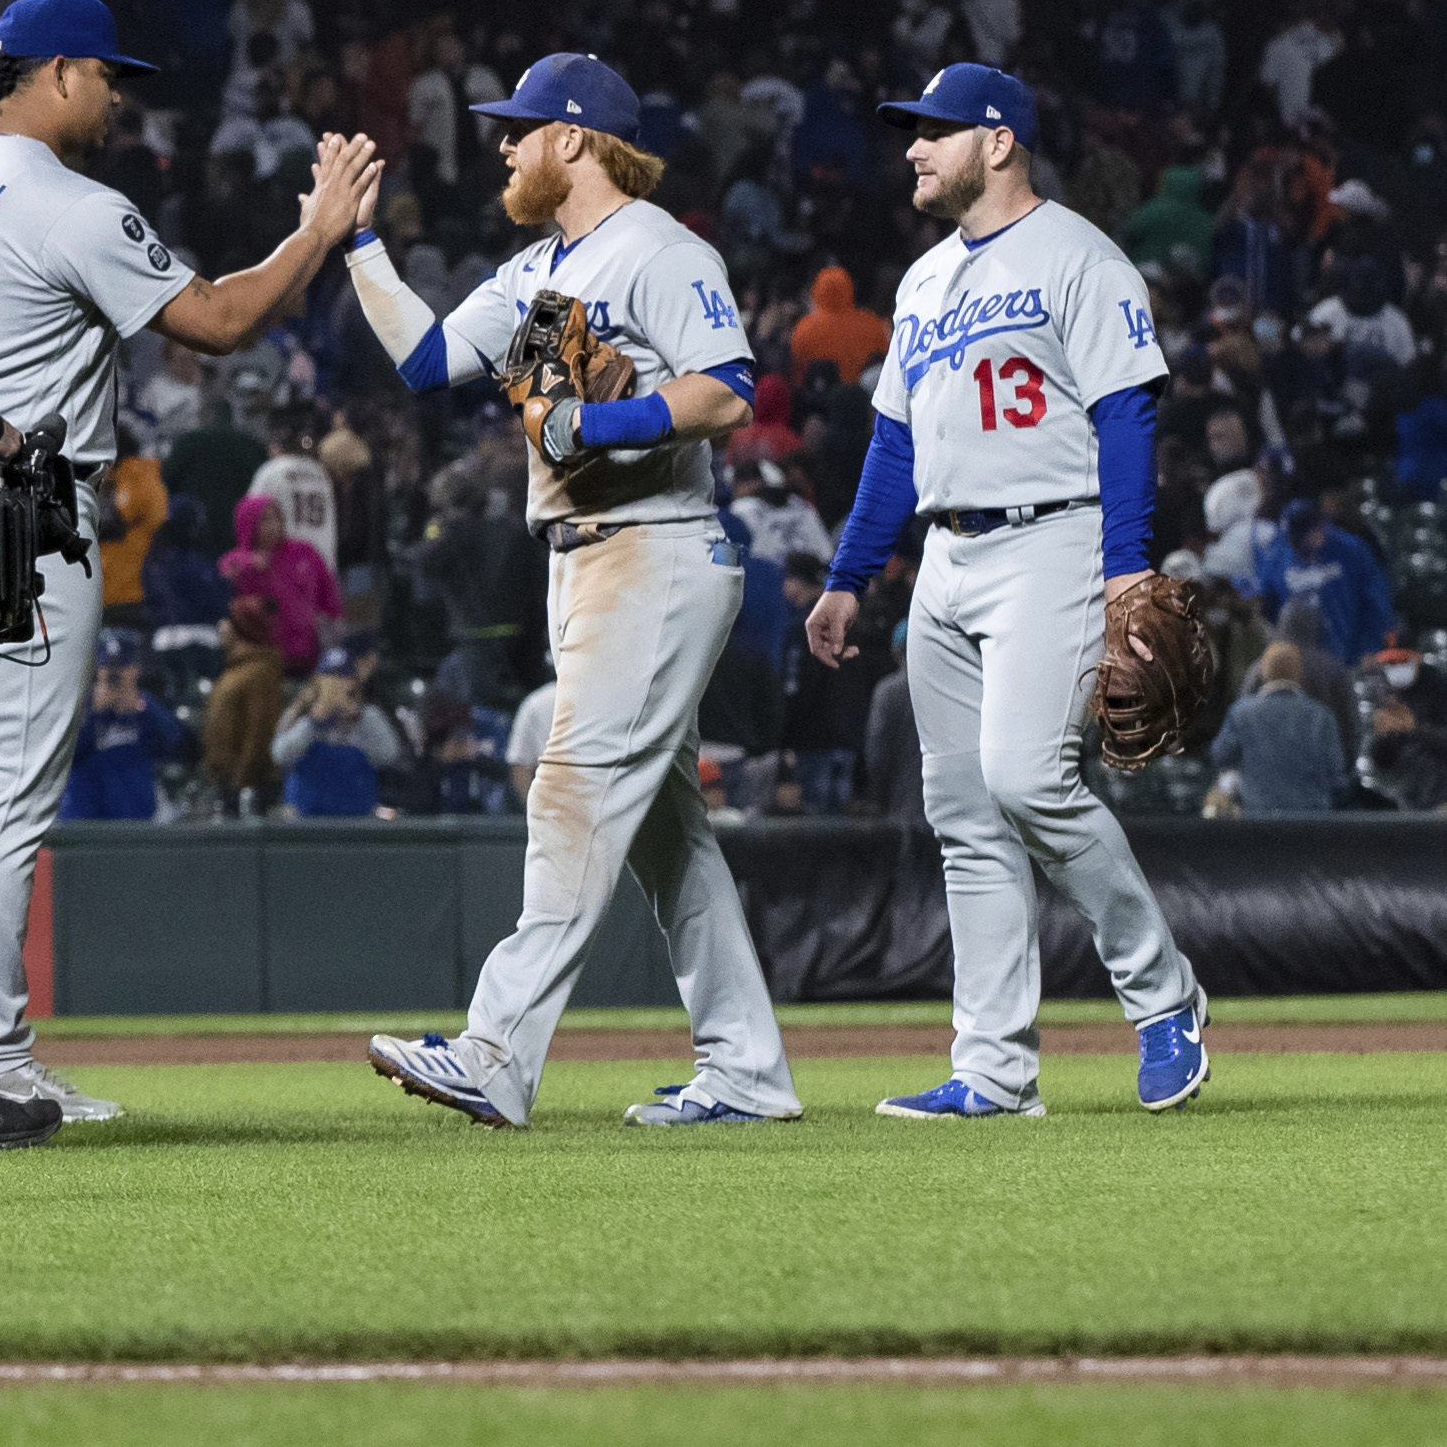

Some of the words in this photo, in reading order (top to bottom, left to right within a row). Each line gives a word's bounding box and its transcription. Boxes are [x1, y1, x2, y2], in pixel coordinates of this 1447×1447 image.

[691, 280, 738, 329] LA
[895, 287, 1050, 375] Dodgers
[1119, 299, 1157, 349] LA
[973, 357, 1047, 432] 13
